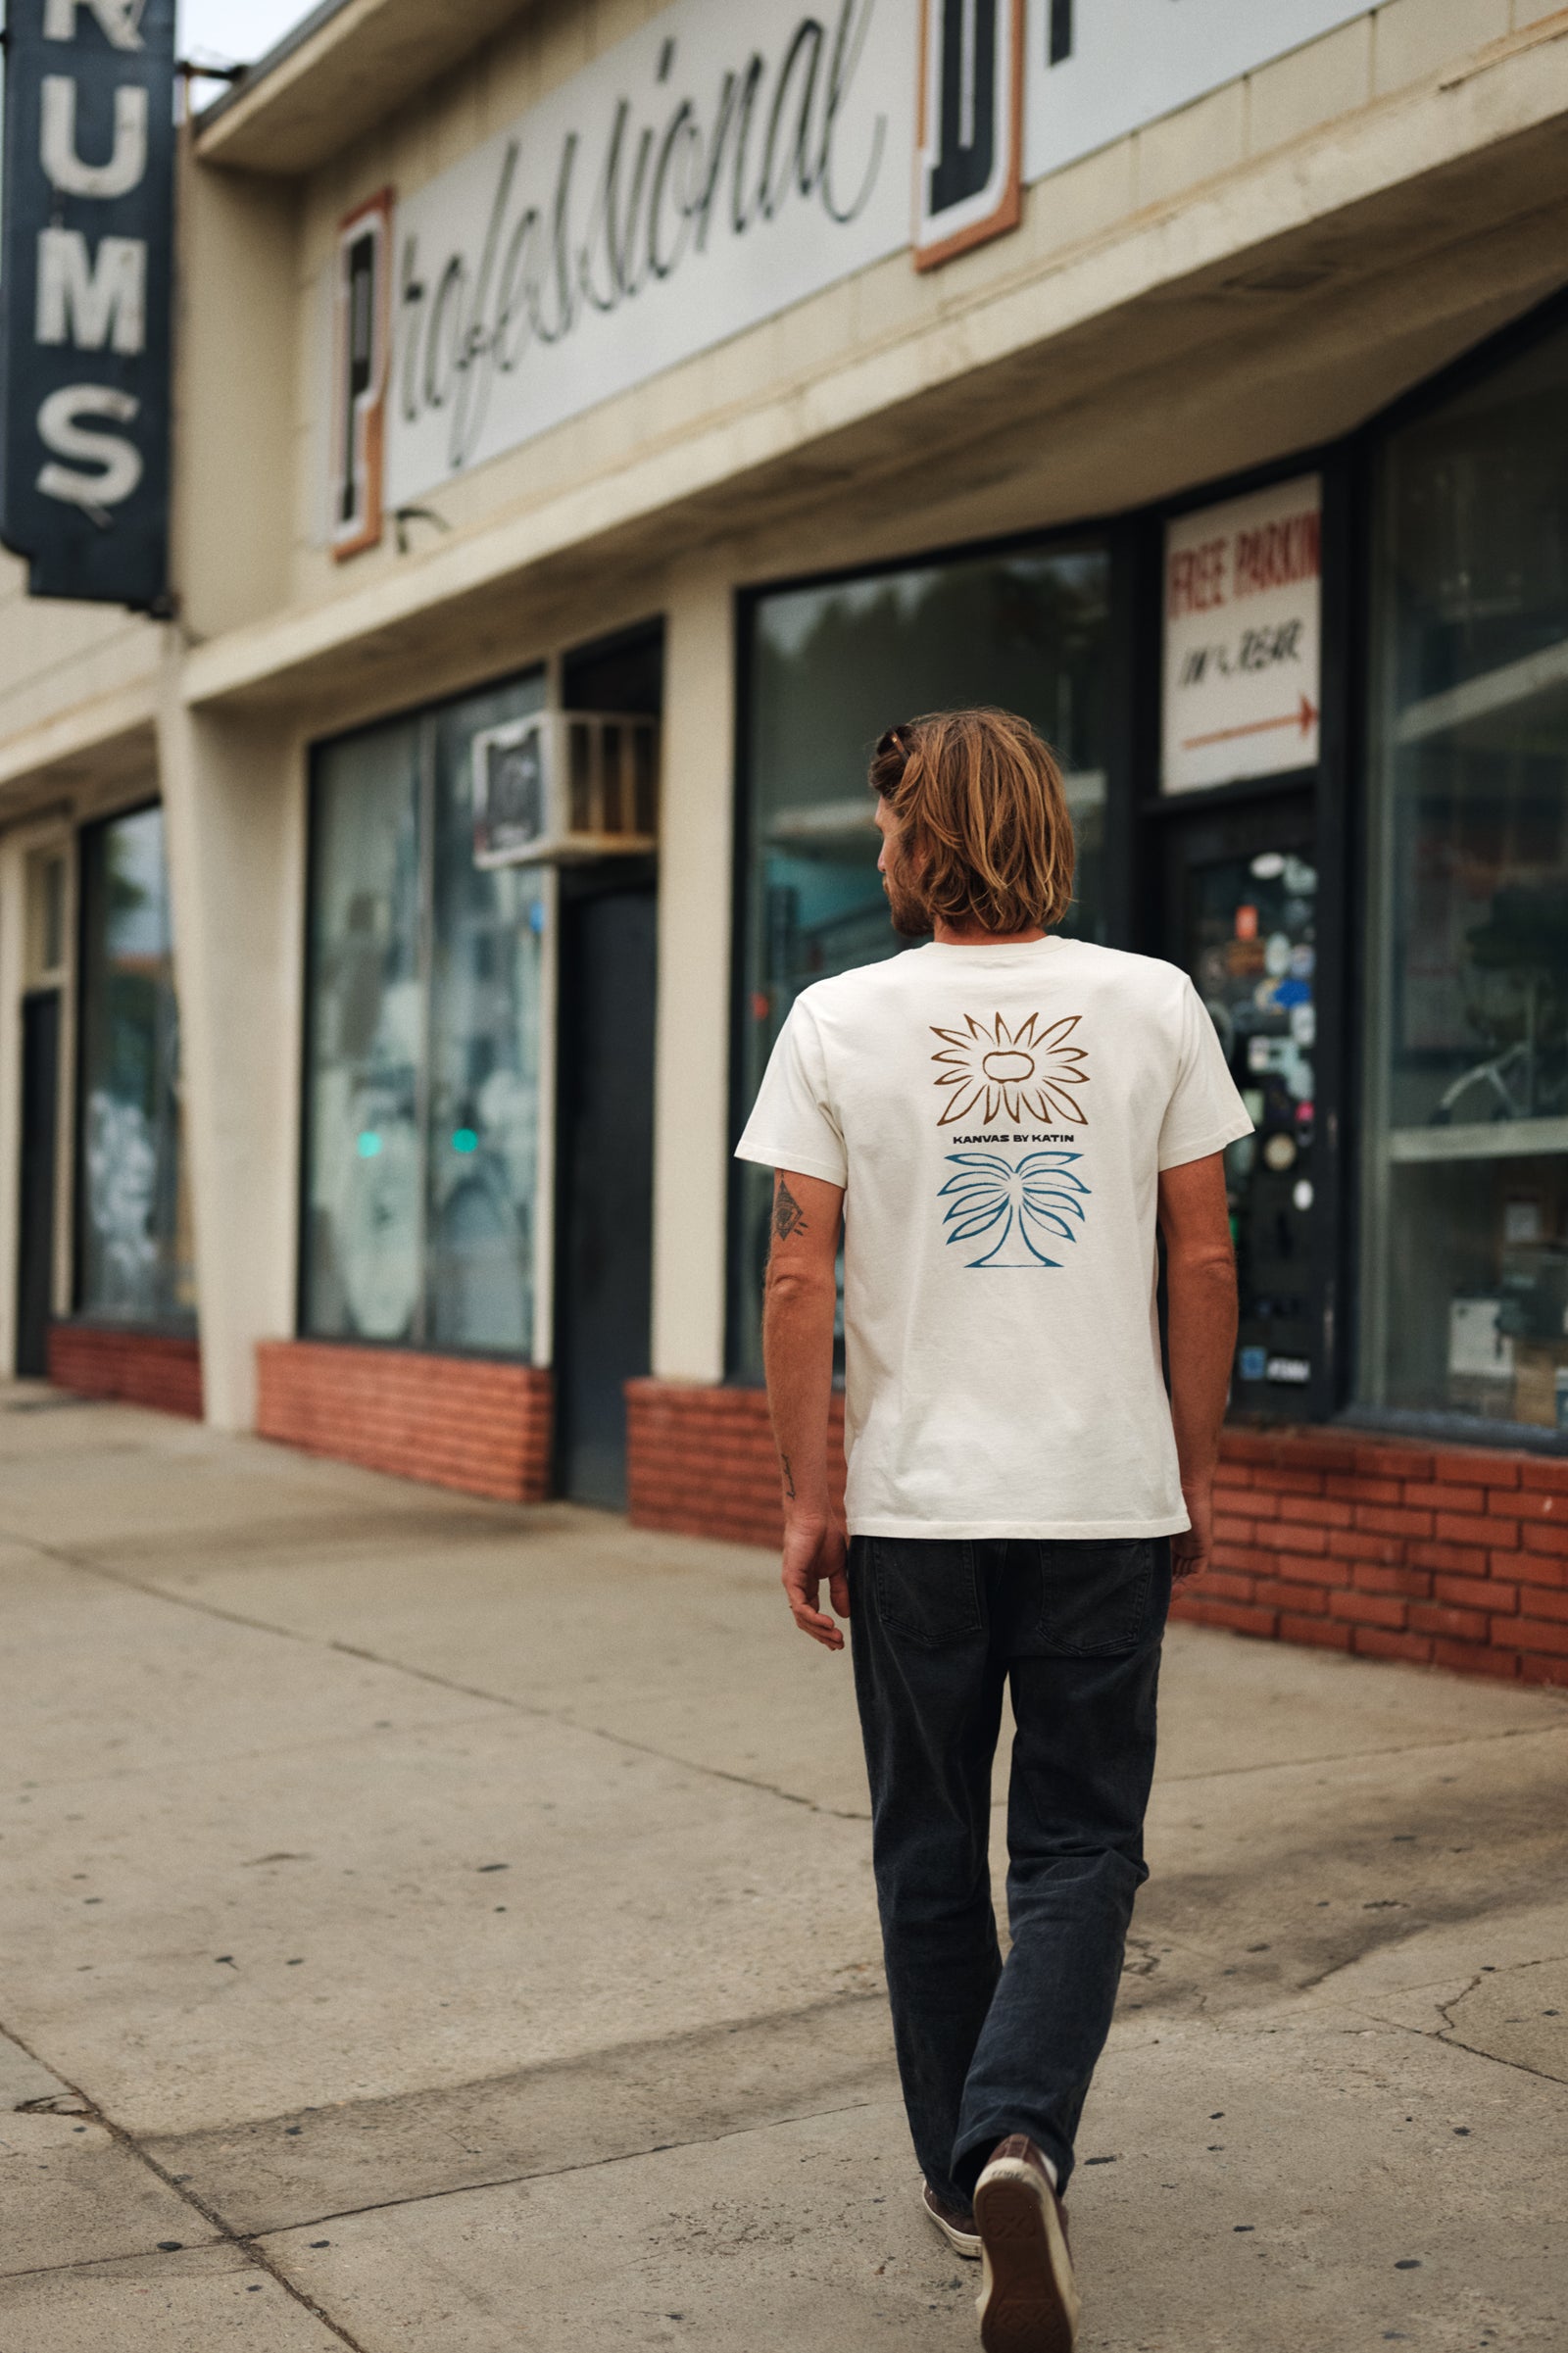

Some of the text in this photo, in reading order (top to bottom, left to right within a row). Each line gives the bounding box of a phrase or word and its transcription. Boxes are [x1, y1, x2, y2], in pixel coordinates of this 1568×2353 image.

[1167, 539, 1226, 619] FREE
[953, 1135, 1010, 1145] KANVAS
[1031, 1134, 1075, 1143] KATIN
